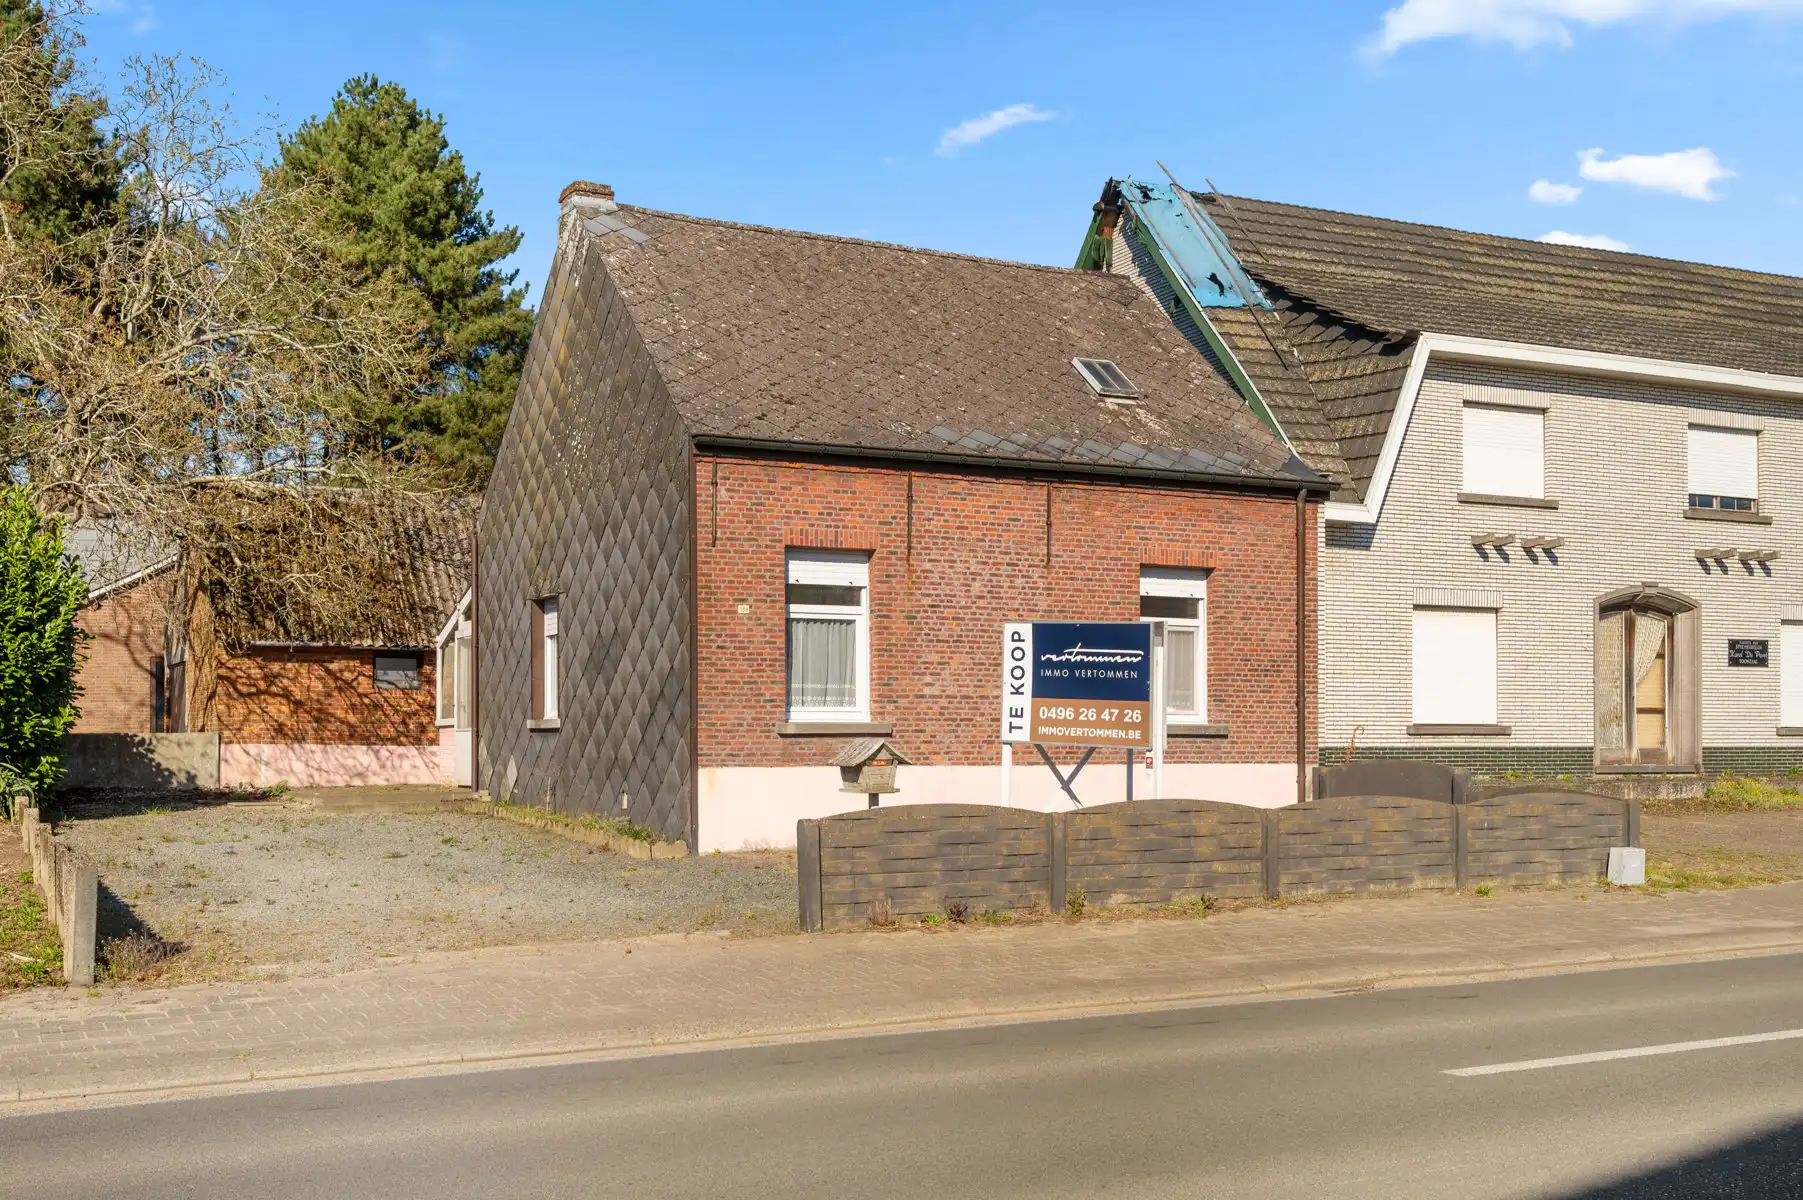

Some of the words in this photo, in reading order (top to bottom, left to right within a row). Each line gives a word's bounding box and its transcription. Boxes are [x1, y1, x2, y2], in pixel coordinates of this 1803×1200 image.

[1010, 631, 1025, 695] KOOP
[1041, 669, 1069, 677] IMMO
[1075, 669, 1138, 679] VERTOMMEN
[1009, 707, 1024, 733] TE
[1039, 706, 1074, 720] 0496
[1079, 708, 1097, 721] 26
[1101, 708, 1119, 722] 47
[1124, 709, 1141, 722] 26
[1038, 726, 1141, 739] IMMOVERTOMMEN.BE
